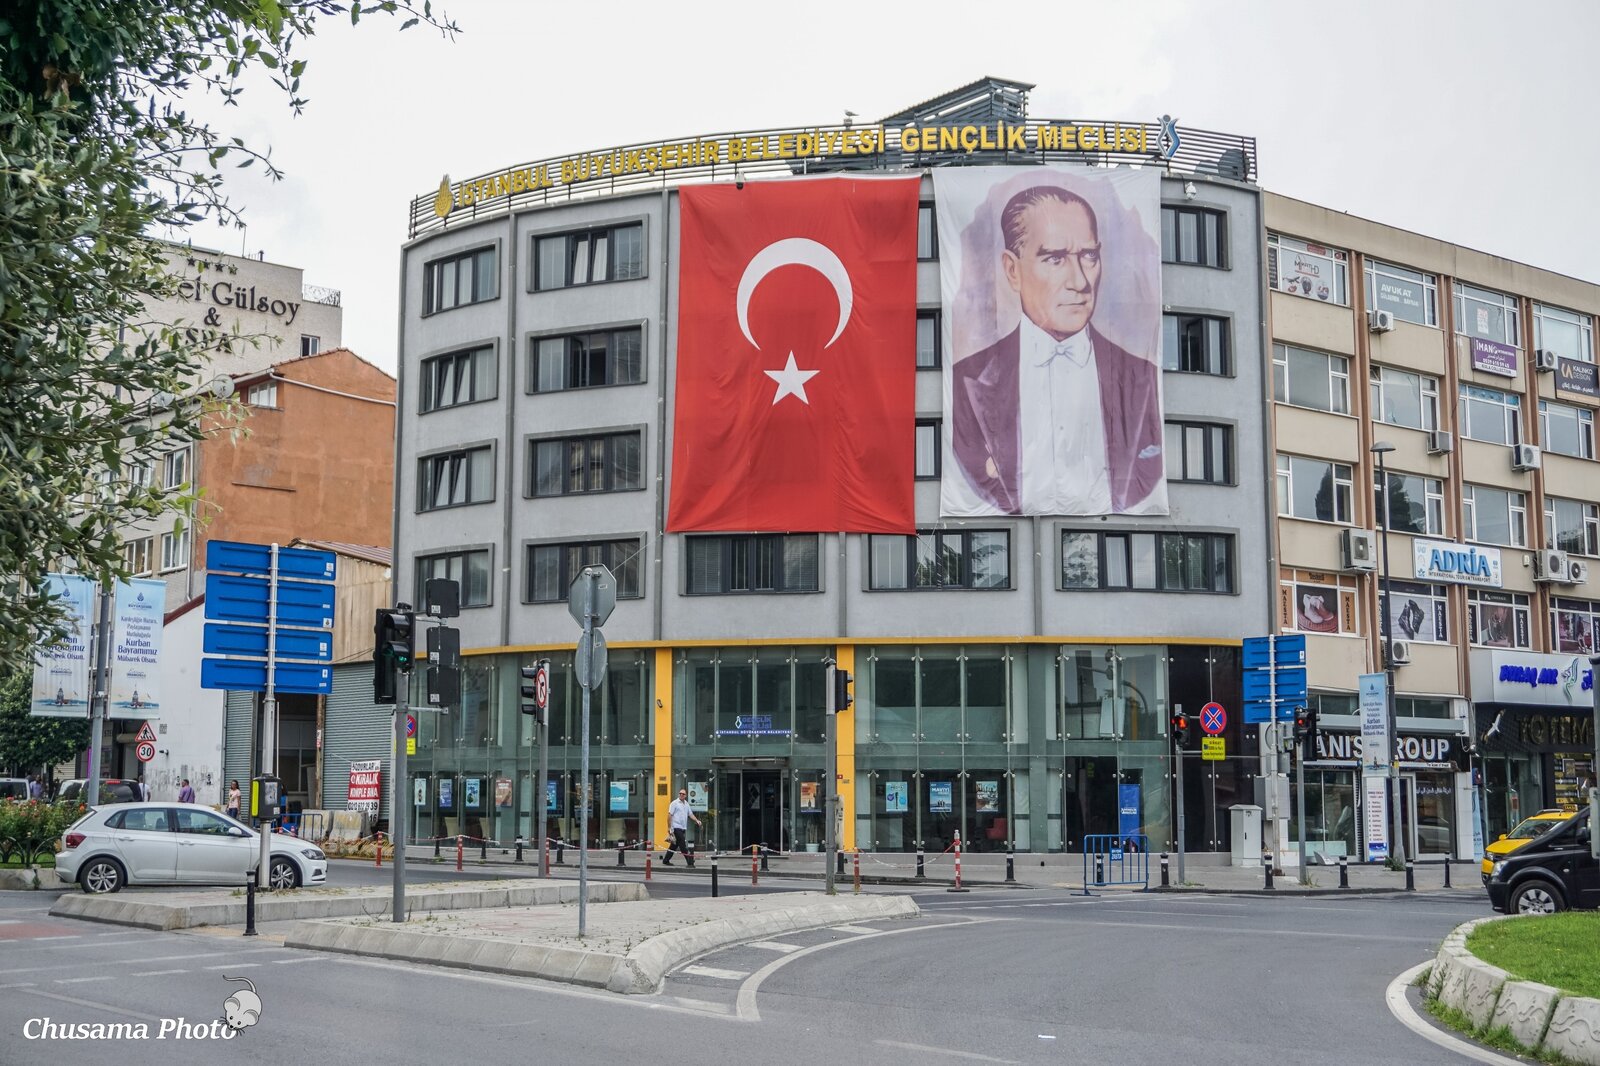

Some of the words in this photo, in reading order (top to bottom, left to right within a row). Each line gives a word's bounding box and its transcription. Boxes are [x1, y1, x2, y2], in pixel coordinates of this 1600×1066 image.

[458, 164, 553, 207] İSTANBUL
[561, 137, 720, 184] BÜYÜKŞEHİR
[728, 124, 884, 162] BELEDİYESİ
[901, 120, 1027, 154] GENÇLİK
[1037, 121, 1147, 153] MECLİSİ
[1381, 284, 1412, 297] AVUKAT
[212, 282, 300, 326] Gülsoy
[204, 307, 221, 326] &
[126, 638, 151, 647] Kurban
[118, 645, 158, 655] Bayramımız
[117, 655, 140, 663] Mübarek
[141, 747, 152, 757] 30
[370, 802, 378, 810] 39
